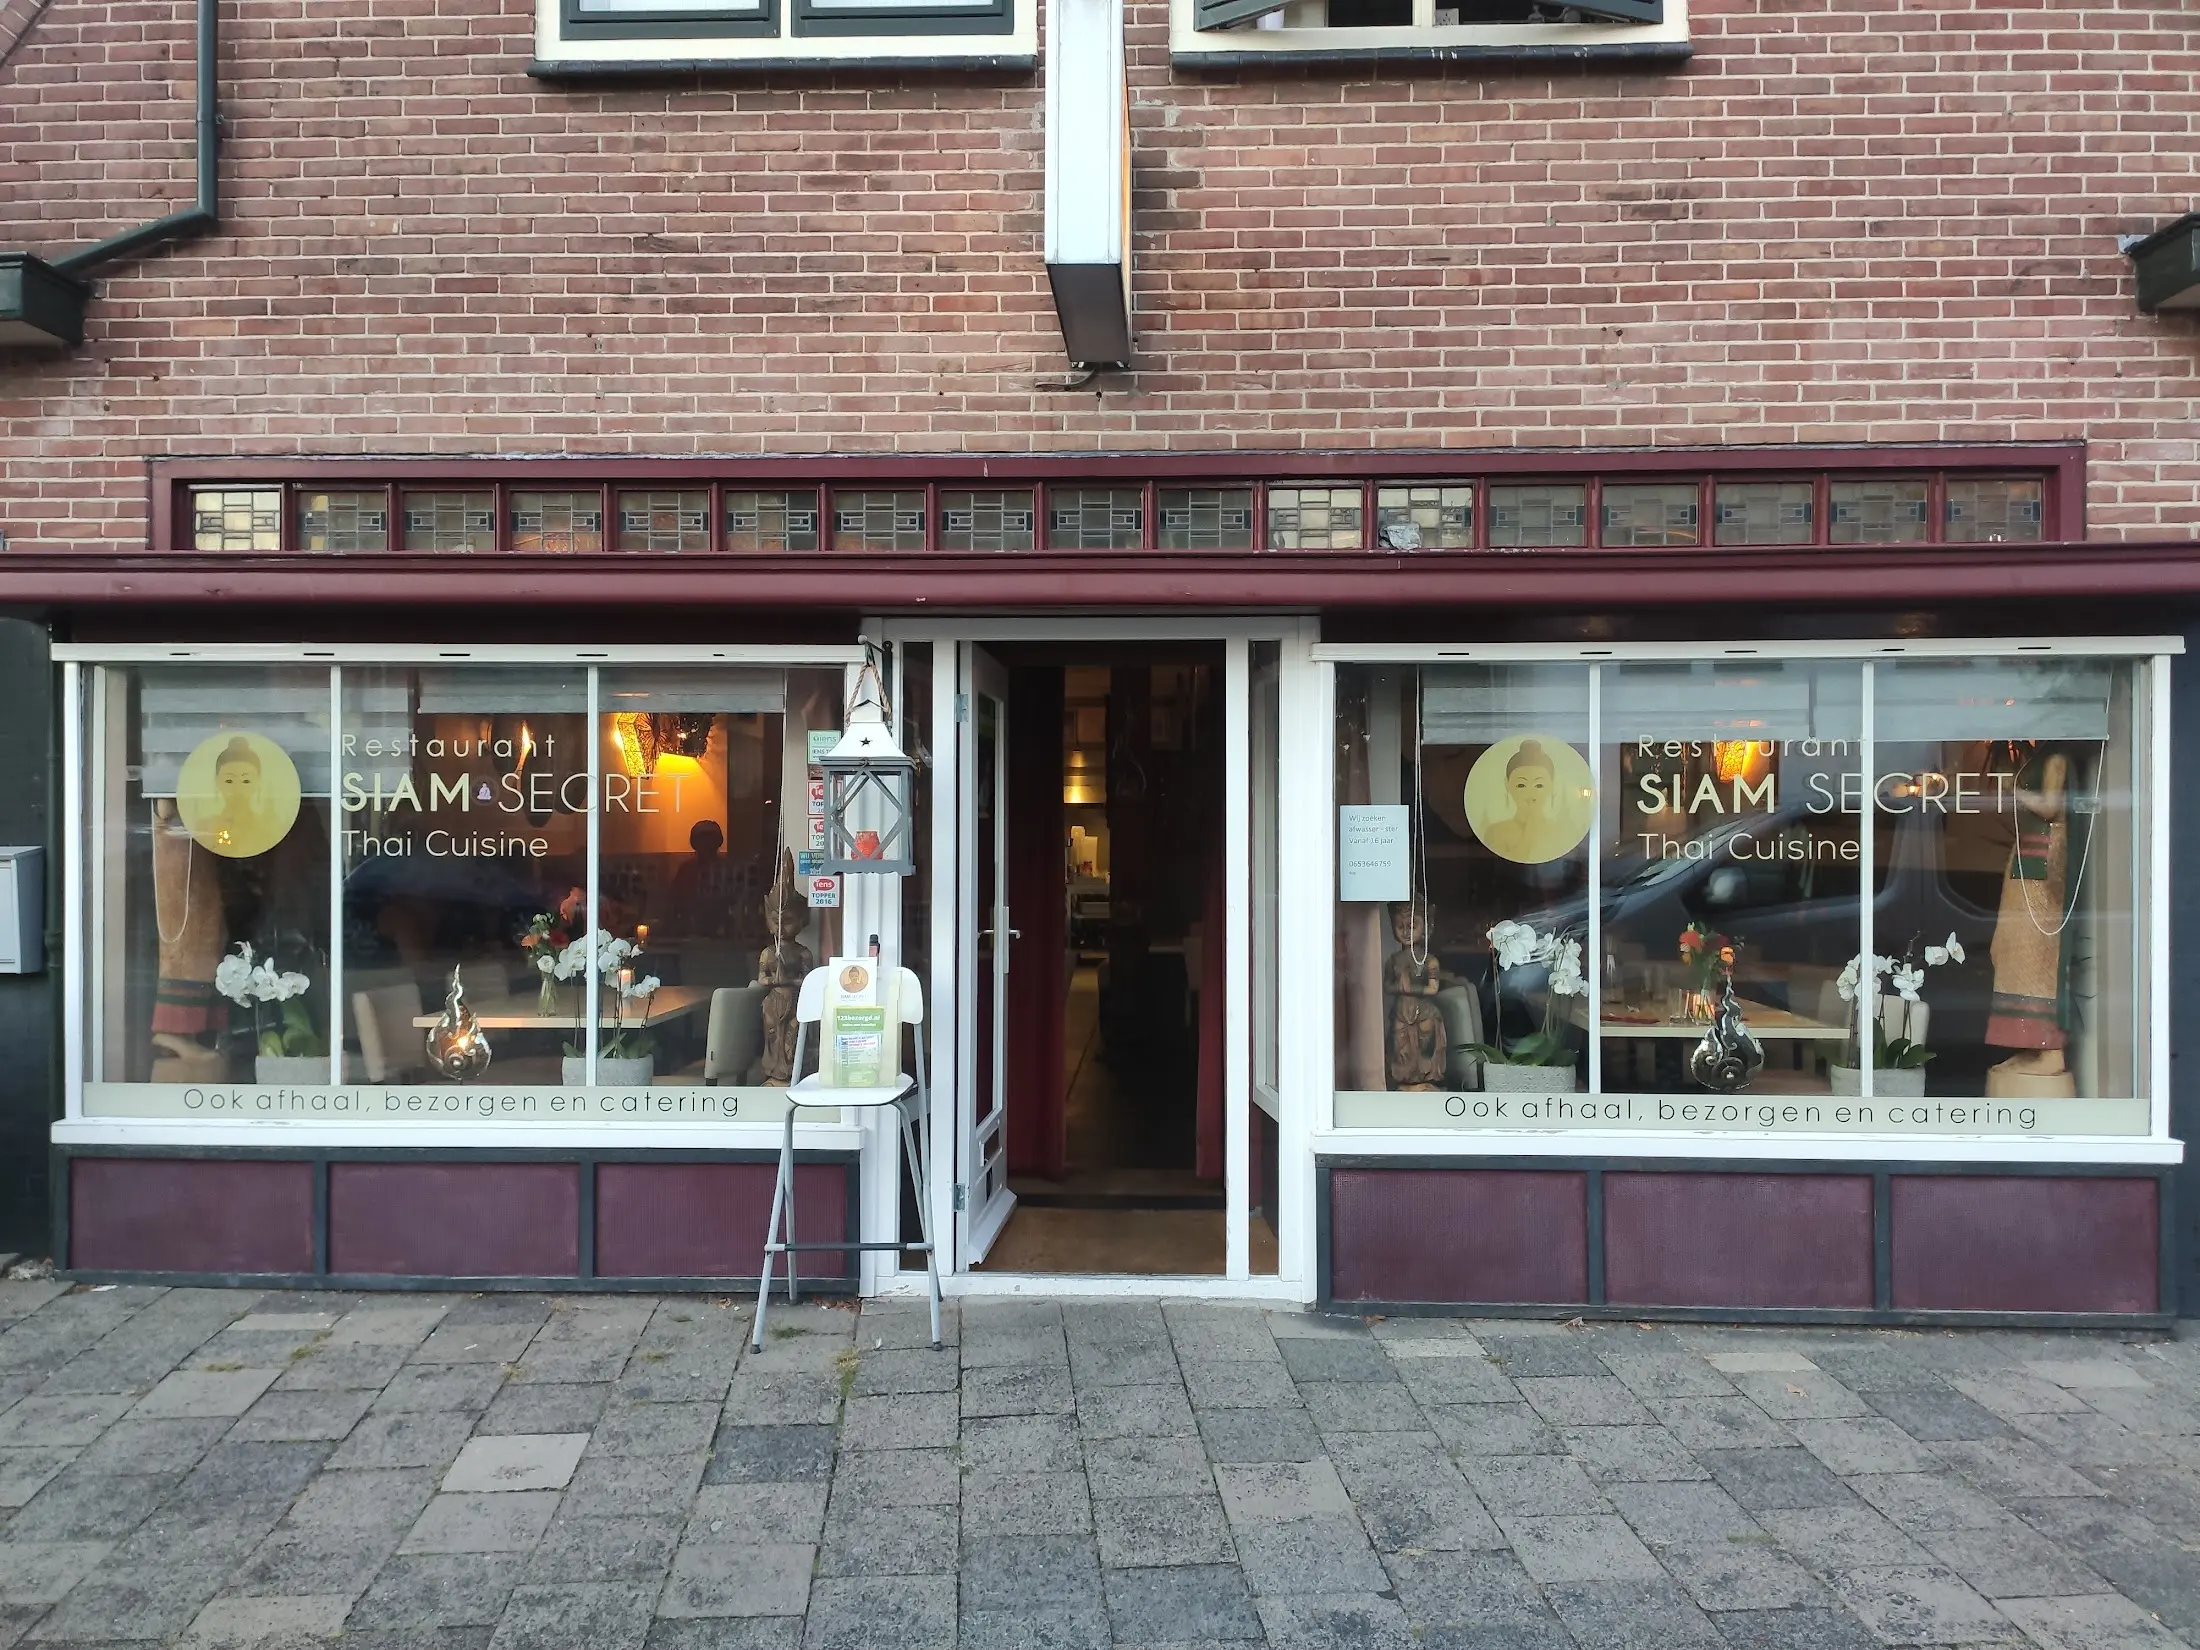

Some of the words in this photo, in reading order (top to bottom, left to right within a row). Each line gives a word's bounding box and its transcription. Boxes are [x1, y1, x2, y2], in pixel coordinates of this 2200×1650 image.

[341, 733, 555, 758] Restaurant
[1637, 734, 1866, 758] Restaurant
[340, 772, 470, 814] SIAM
[498, 772, 690, 814] SECRET
[1636, 773, 1775, 815] SIAM
[1806, 772, 2015, 815] SECRET
[1361, 814, 1386, 822] zoeken
[340, 829, 412, 857] Thai
[425, 829, 549, 858] Cuisine
[1379, 837, 1394, 845] jaar
[1636, 833, 1714, 860] Thai
[1728, 832, 1860, 861] Cuisine
[815, 880, 833, 888] iens
[184, 1088, 244, 1110] Ook
[256, 1089, 371, 1113] afhaal,
[385, 1090, 536, 1117] bezorgen
[550, 1094, 586, 1112] en
[599, 1091, 738, 1118] catering
[1444, 1096, 1509, 1118] Ook
[1521, 1097, 1643, 1121] afhaal,
[1658, 1099, 1821, 1127] bezorgen
[1835, 1105, 1874, 1123] en
[1888, 1102, 2037, 1130] catering
